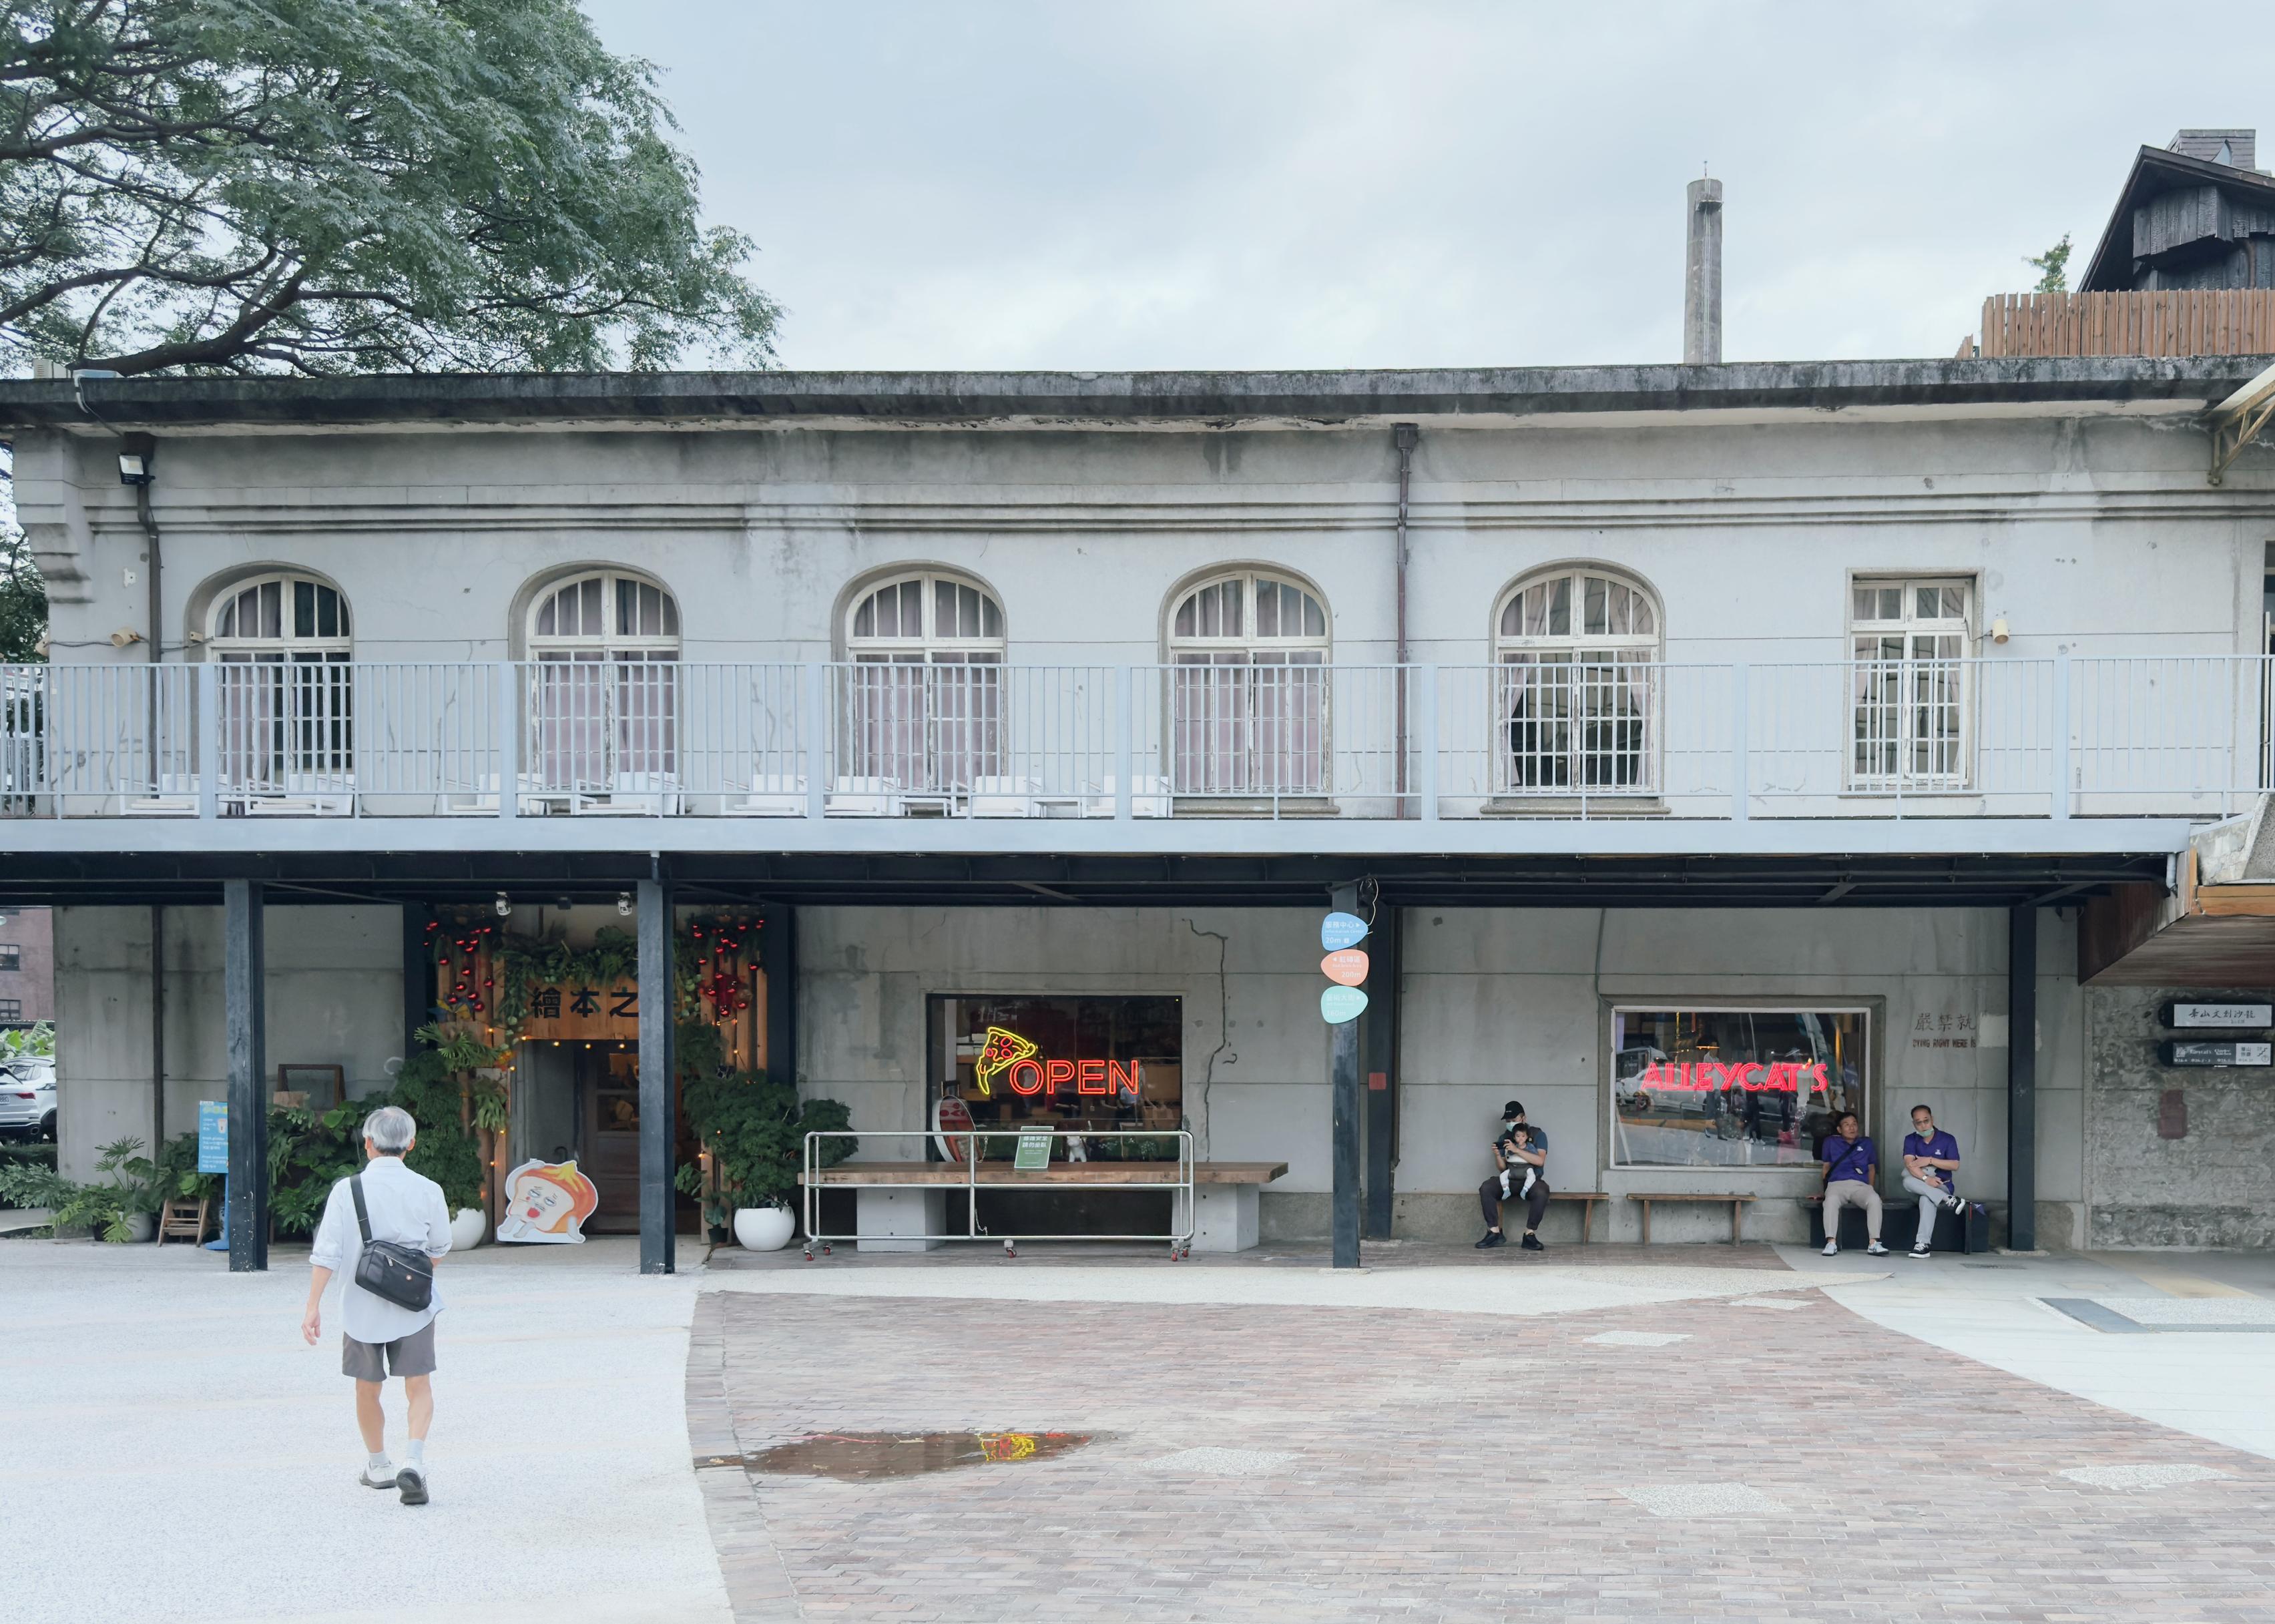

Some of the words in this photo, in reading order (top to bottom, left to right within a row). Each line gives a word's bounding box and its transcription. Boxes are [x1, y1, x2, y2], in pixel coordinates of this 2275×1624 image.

[531, 987, 639, 1019] 繪本之
[1009, 1059, 1138, 1095] OPEN
[1640, 1061, 1828, 1091] ALLEYCAT'S
